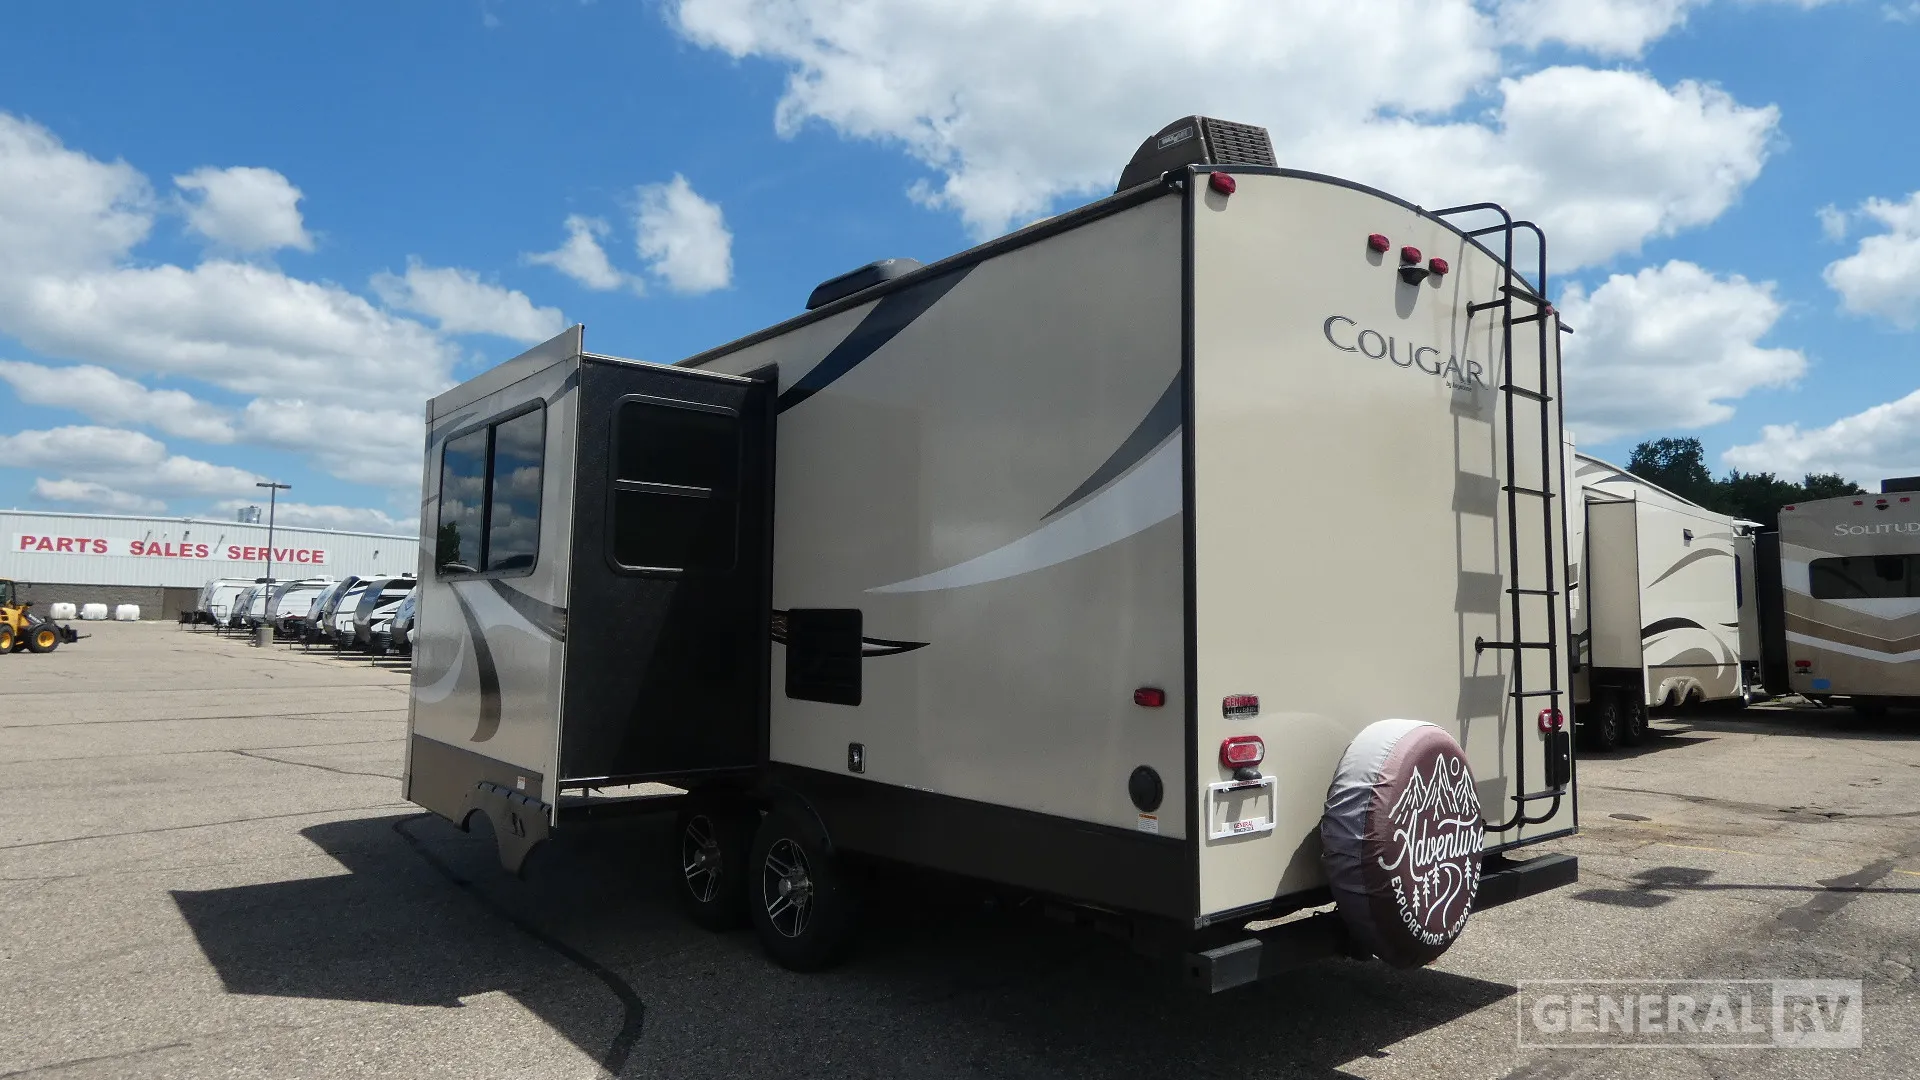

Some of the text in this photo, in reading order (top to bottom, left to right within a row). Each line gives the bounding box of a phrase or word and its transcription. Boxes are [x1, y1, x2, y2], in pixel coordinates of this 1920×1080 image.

[1323, 315, 1489, 390] COUGAR
[20, 535, 325, 564] PARTS SALES SERVICE
[1378, 808, 1484, 882] Adventure
[1391, 875, 1422, 937] EXPLORE
[1447, 897, 1472, 939] WORRY
[1470, 861, 1482, 898] LESS
